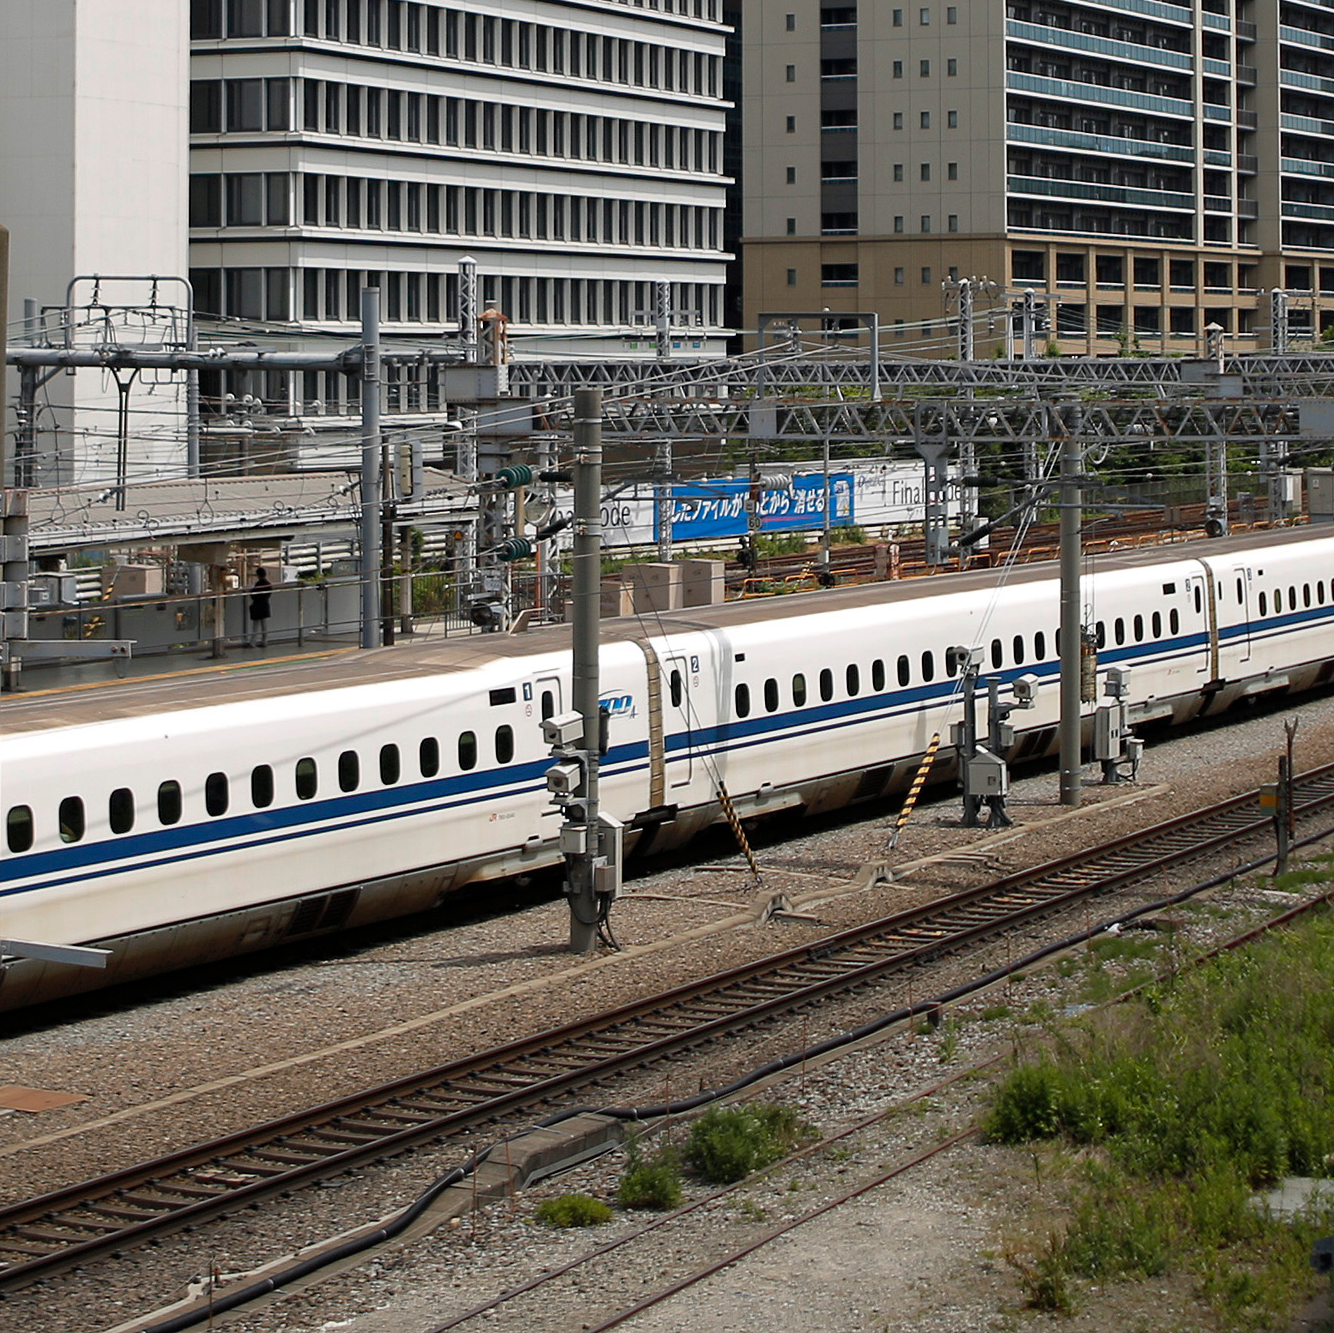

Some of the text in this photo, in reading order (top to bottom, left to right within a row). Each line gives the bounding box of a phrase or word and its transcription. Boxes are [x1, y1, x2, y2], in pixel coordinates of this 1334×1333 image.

[748, 517, 761, 529] 60
[692, 657, 698, 672] 2
[524, 684, 531, 699] 1
